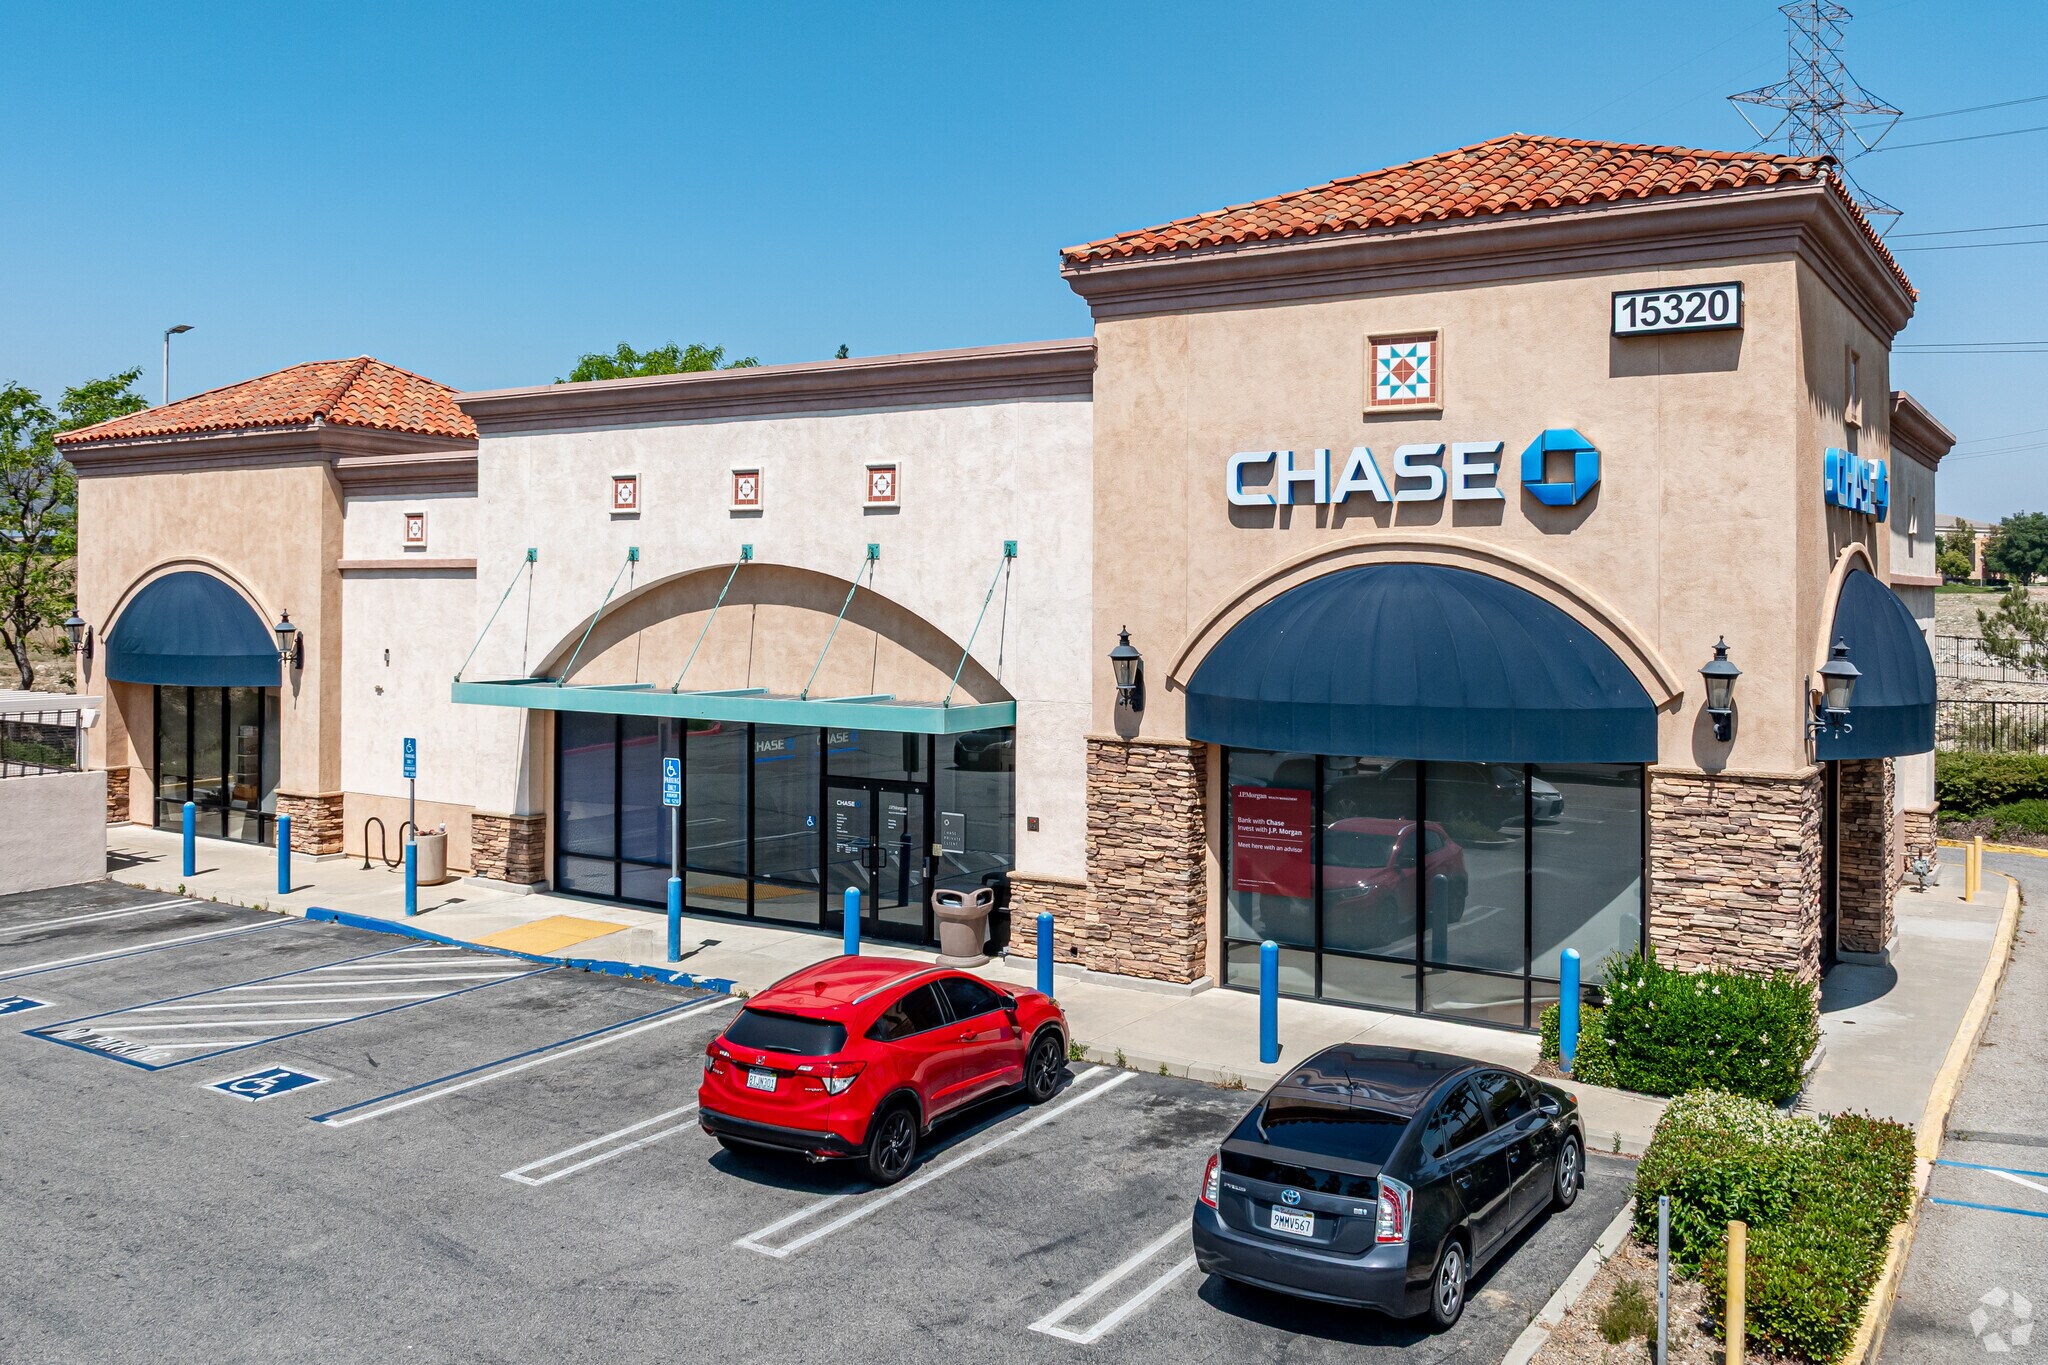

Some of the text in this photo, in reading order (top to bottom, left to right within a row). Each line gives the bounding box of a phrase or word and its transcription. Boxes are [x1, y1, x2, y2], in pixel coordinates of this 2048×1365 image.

[1621, 290, 1730, 328] 15320
[1226, 441, 1505, 506] CHASE
[1825, 448, 1878, 514] CHASE
[755, 740, 785, 752] HASE
[1266, 819, 1285, 827] Chase
[1268, 827, 1278, 835] J.P.
[1279, 828, 1303, 837] Morgan
[1273, 1214, 1311, 1232] 9MMV567
